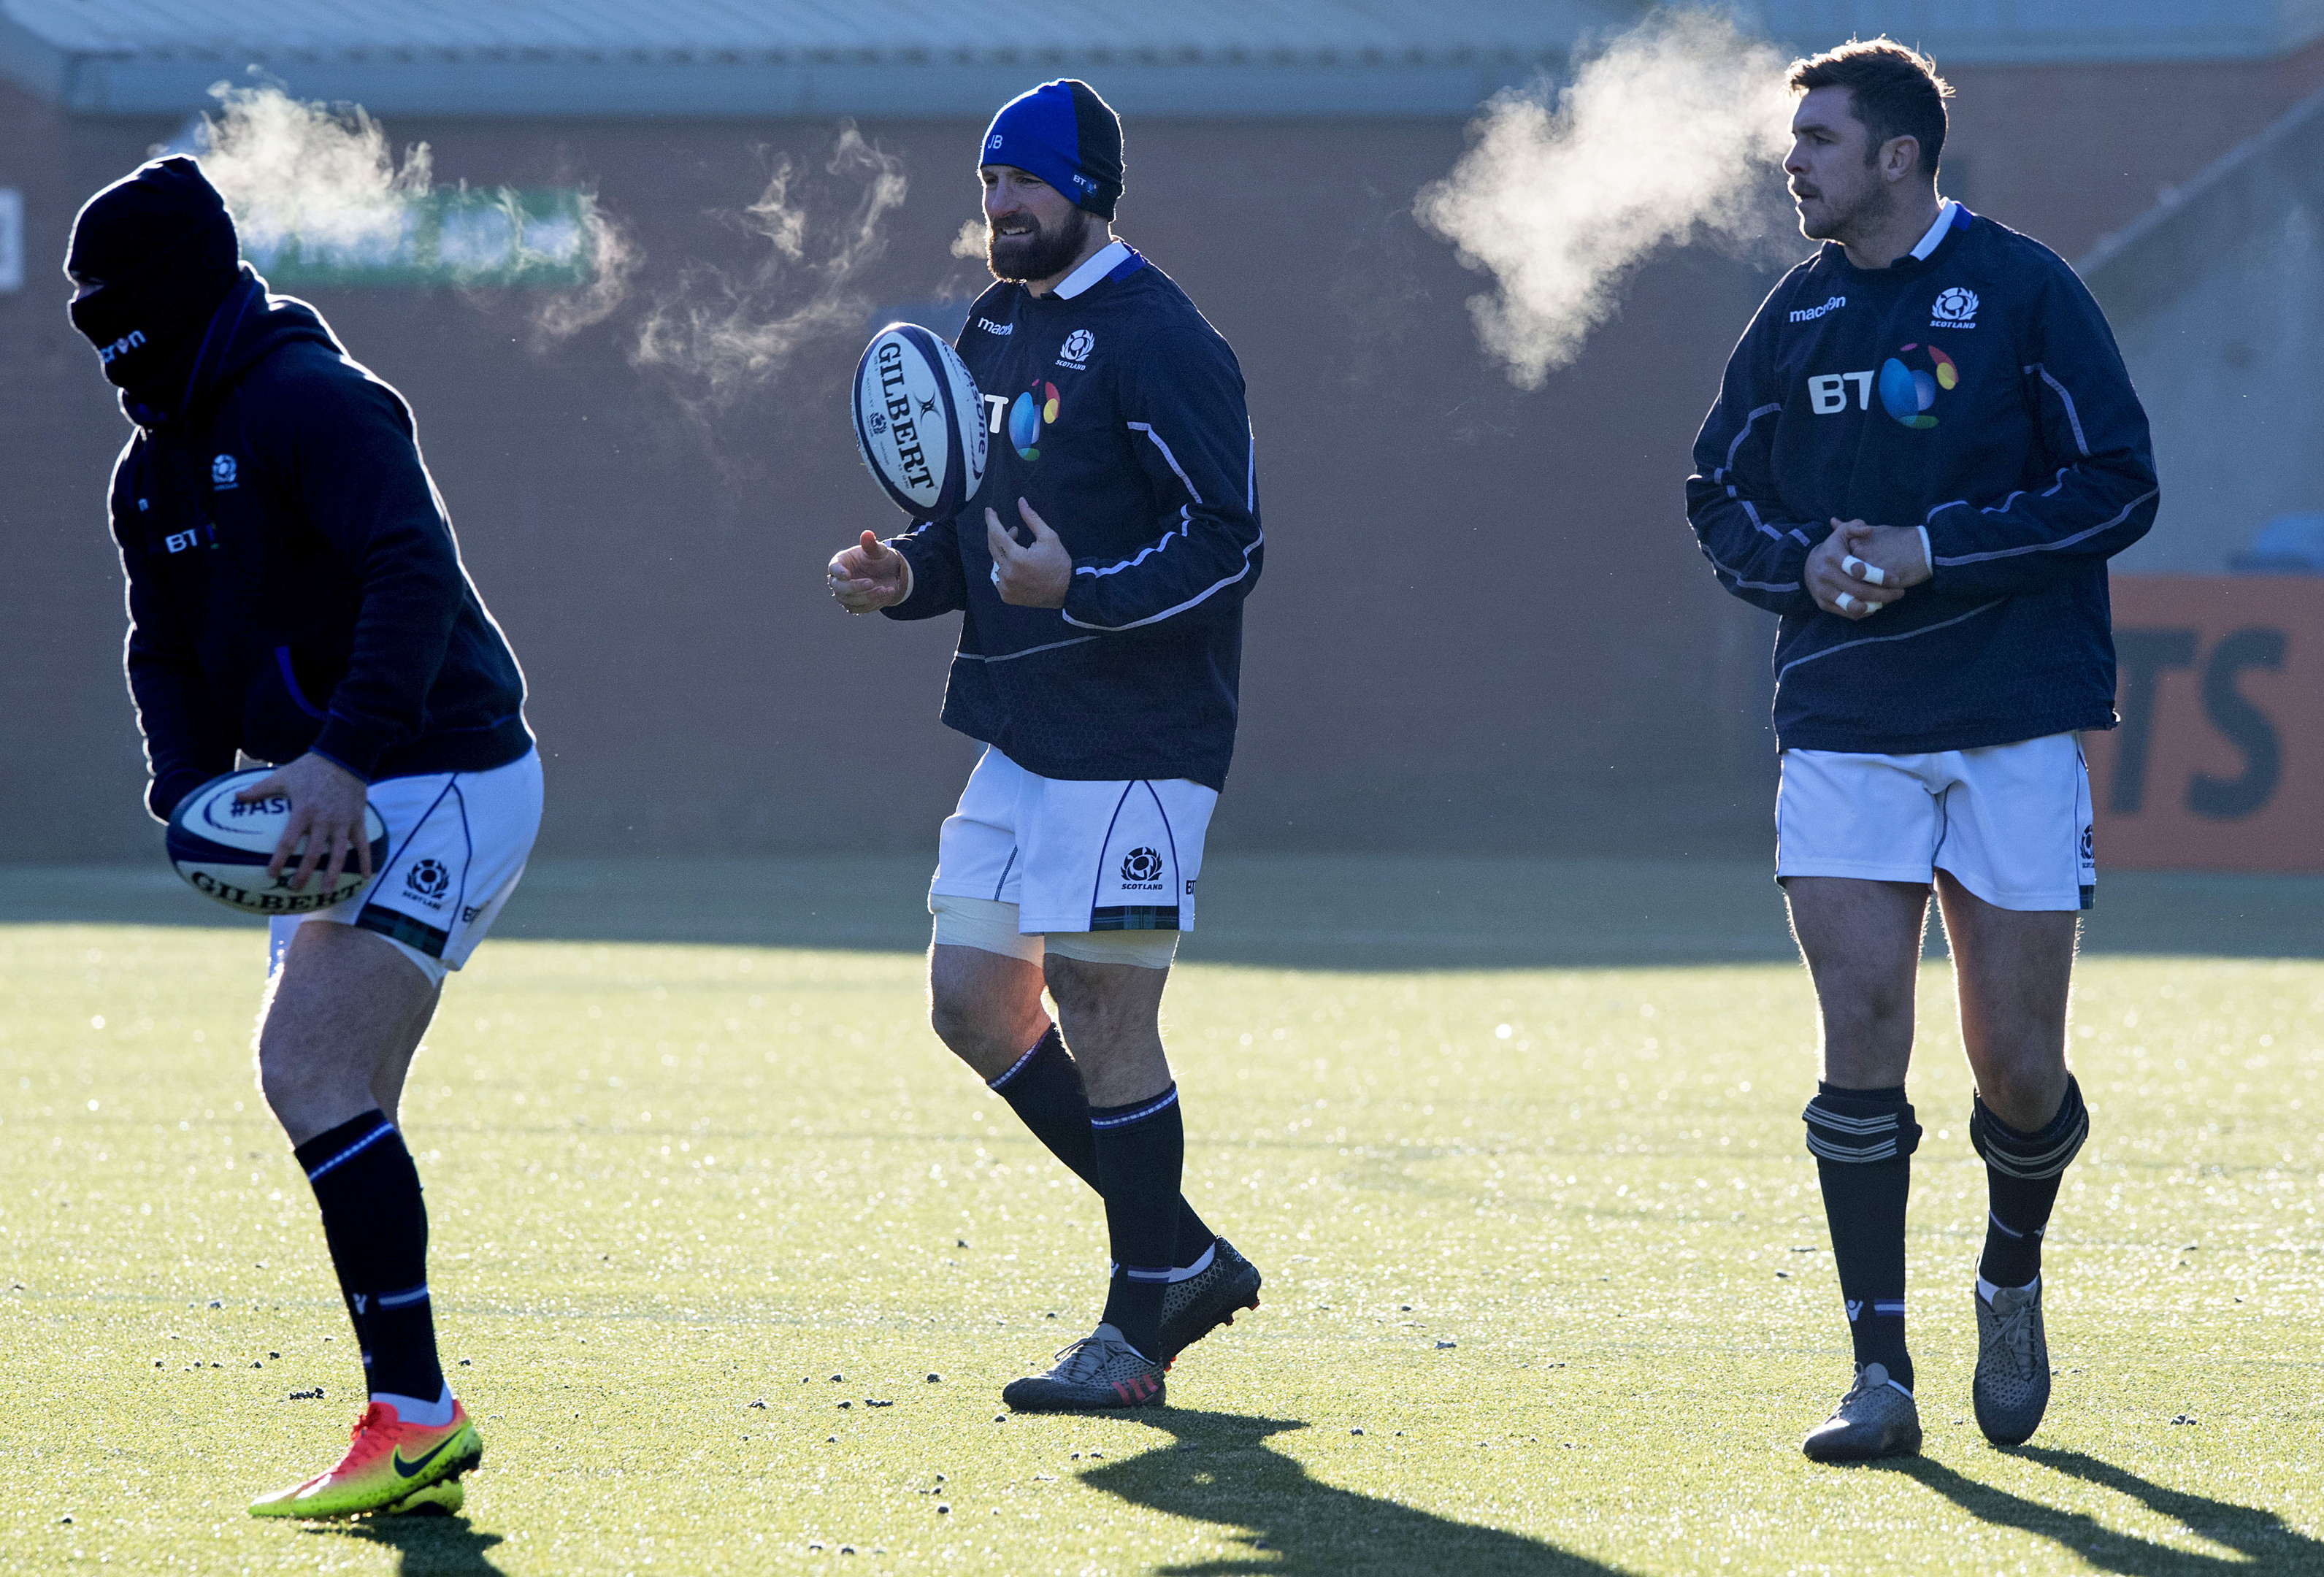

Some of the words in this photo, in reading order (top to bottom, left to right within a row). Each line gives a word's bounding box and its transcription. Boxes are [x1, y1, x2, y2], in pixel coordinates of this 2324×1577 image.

[987, 134, 1003, 150] JB
[1073, 174, 1086, 185] BT
[1790, 296, 1846, 323] macron
[1930, 320, 1976, 329] SCOTLAND
[1054, 359, 1086, 371] SCOTLAND
[1807, 370, 1874, 415] BT
[878, 342, 935, 490] GILBERT
[979, 393, 1009, 434] T
[165, 529, 198, 553] BT
[191, 871, 362, 910] GILBERT
